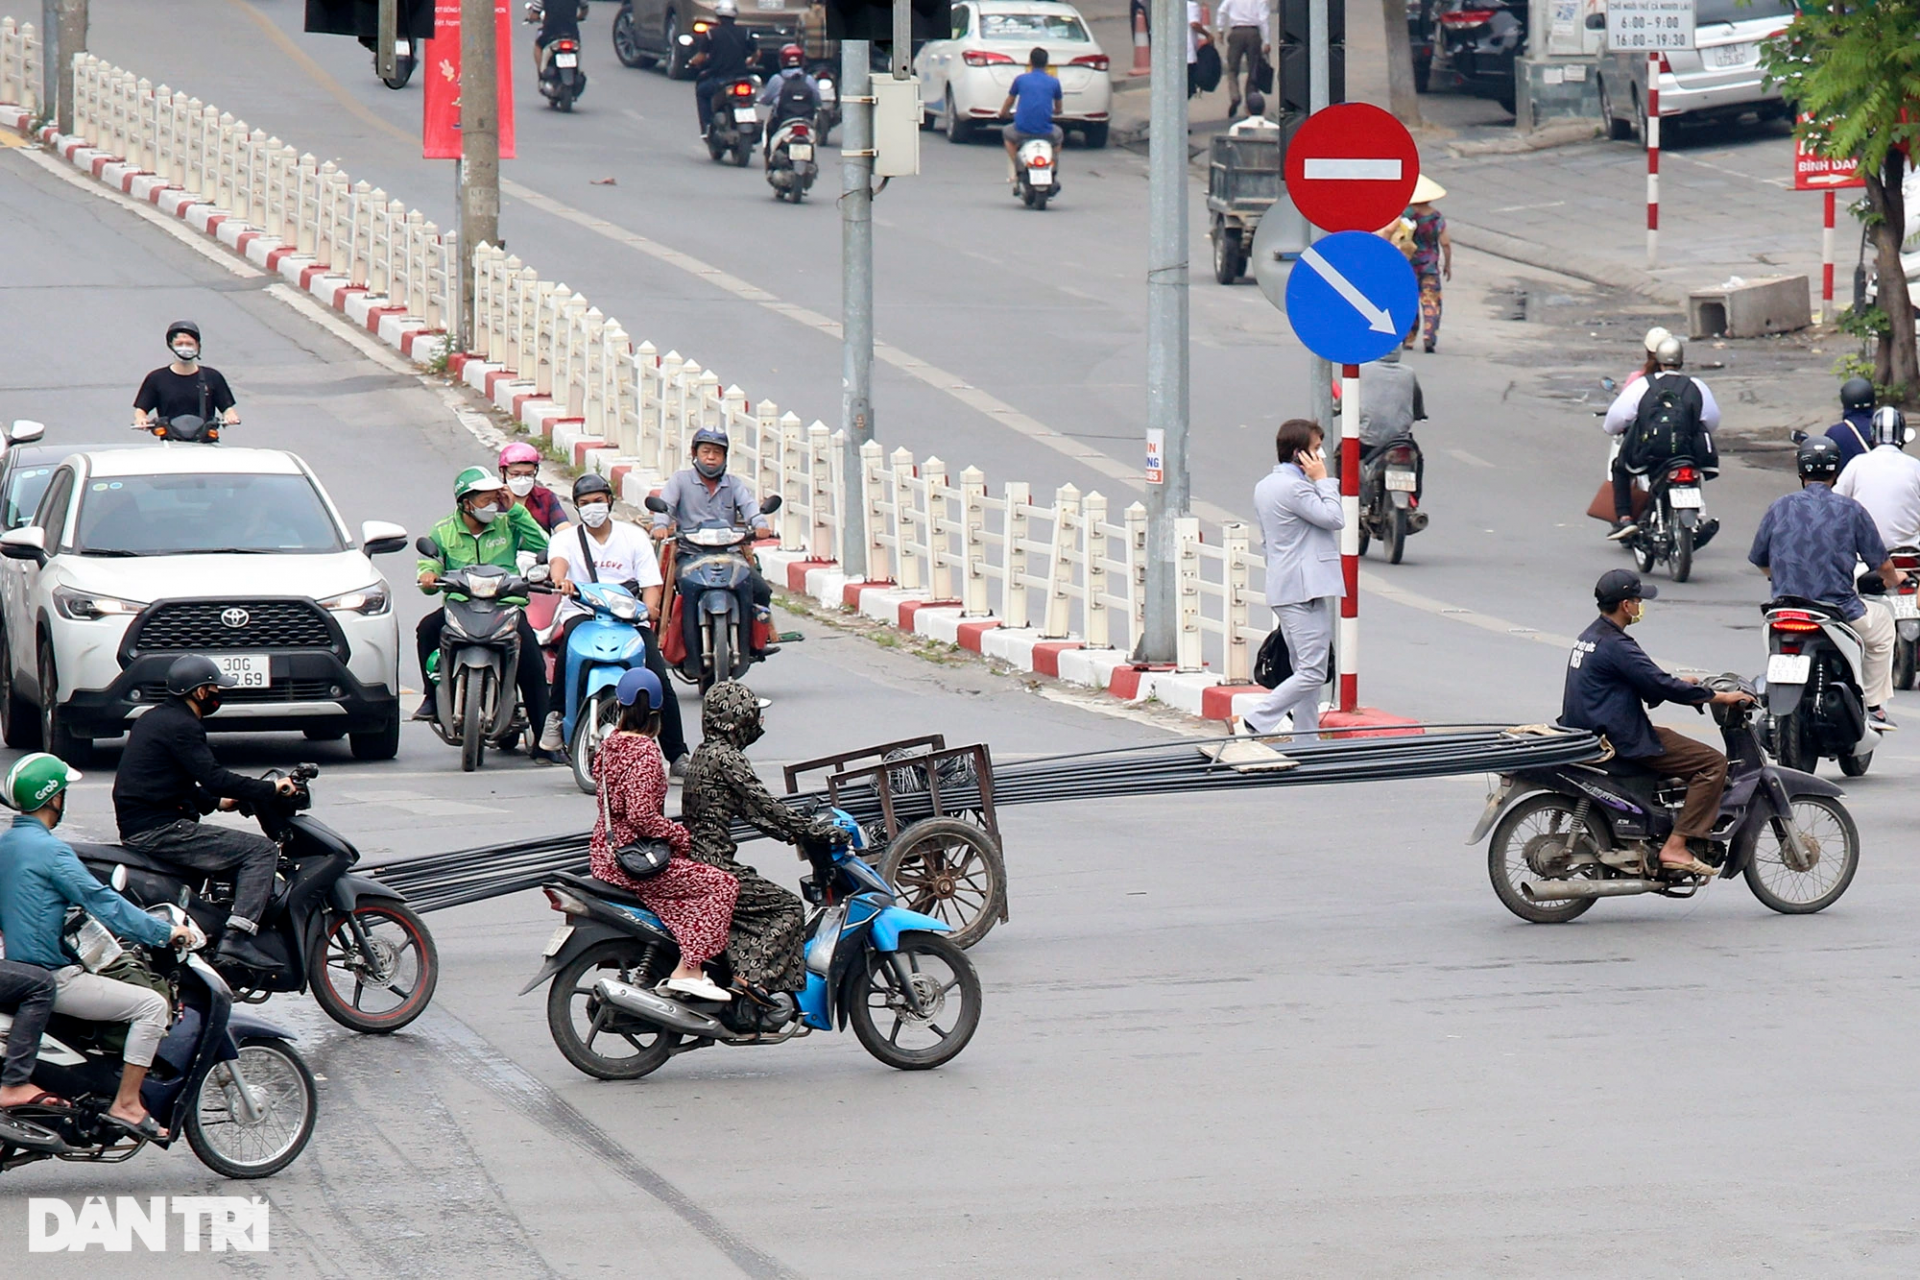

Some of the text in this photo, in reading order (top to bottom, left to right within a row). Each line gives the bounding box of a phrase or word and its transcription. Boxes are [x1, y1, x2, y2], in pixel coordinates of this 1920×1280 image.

[1798, 159, 1829, 172] BÌNH
[1147, 457, 1159, 467] NG
[485, 536, 507, 548] Grab
[223, 658, 251, 671] 30G
[226, 672, 263, 686] 2.69
[35, 779, 59, 800] Grab
